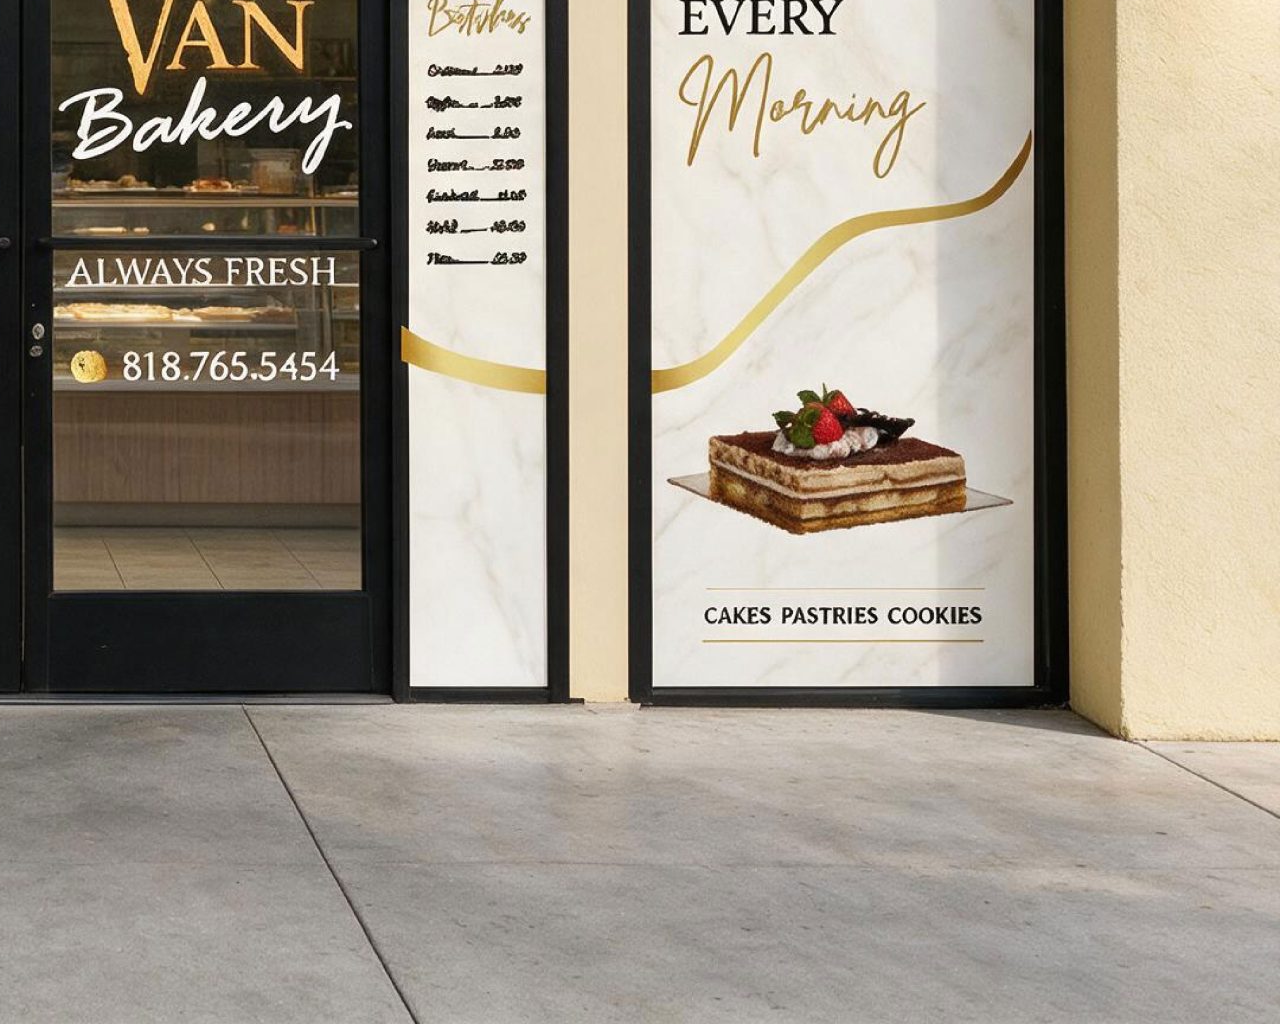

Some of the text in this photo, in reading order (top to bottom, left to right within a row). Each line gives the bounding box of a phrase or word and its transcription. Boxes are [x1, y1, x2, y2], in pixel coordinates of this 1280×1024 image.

[58, 76, 353, 175] Bakery
[678, 52, 927, 179] Morning
[65, 257, 336, 287] ALWAYS FRESH
[123, 351, 340, 382] 818.765.5454
[704, 606, 982, 625] CAKES PASTRIES COOKIES
